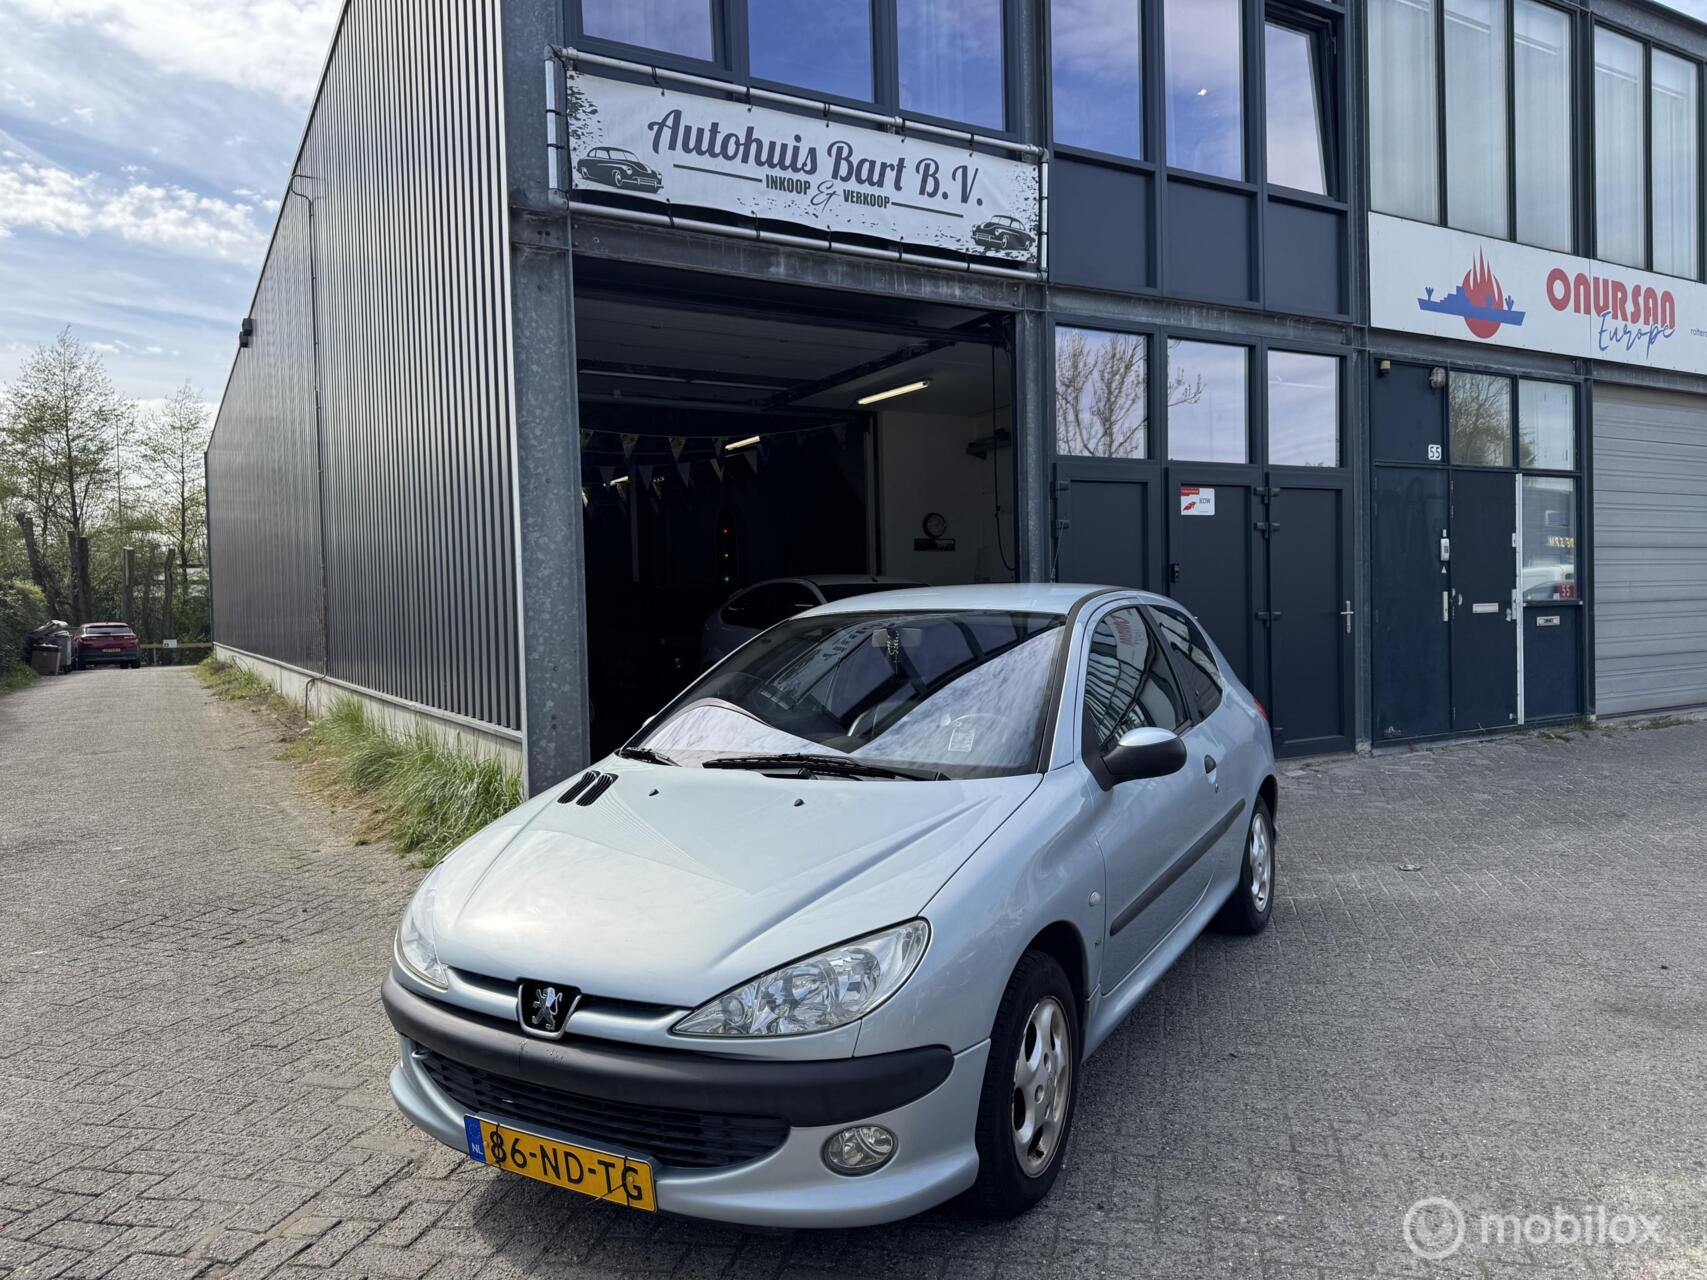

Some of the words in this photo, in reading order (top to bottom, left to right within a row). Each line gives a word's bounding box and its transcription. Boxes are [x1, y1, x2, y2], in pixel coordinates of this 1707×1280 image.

[648, 109, 818, 176] Autohuis
[827, 140, 906, 192] Bart
[915, 157, 984, 207] B.V.
[765, 173, 811, 196] INKOOP
[842, 188, 891, 209] VERKOOP
[1598, 310, 1676, 360] Europe
[1430, 446, 1440, 459] 55
[1561, 584, 1571, 597] 55
[471, 1142, 484, 1156] NL
[489, 1130, 643, 1201] 86-ND-TG
